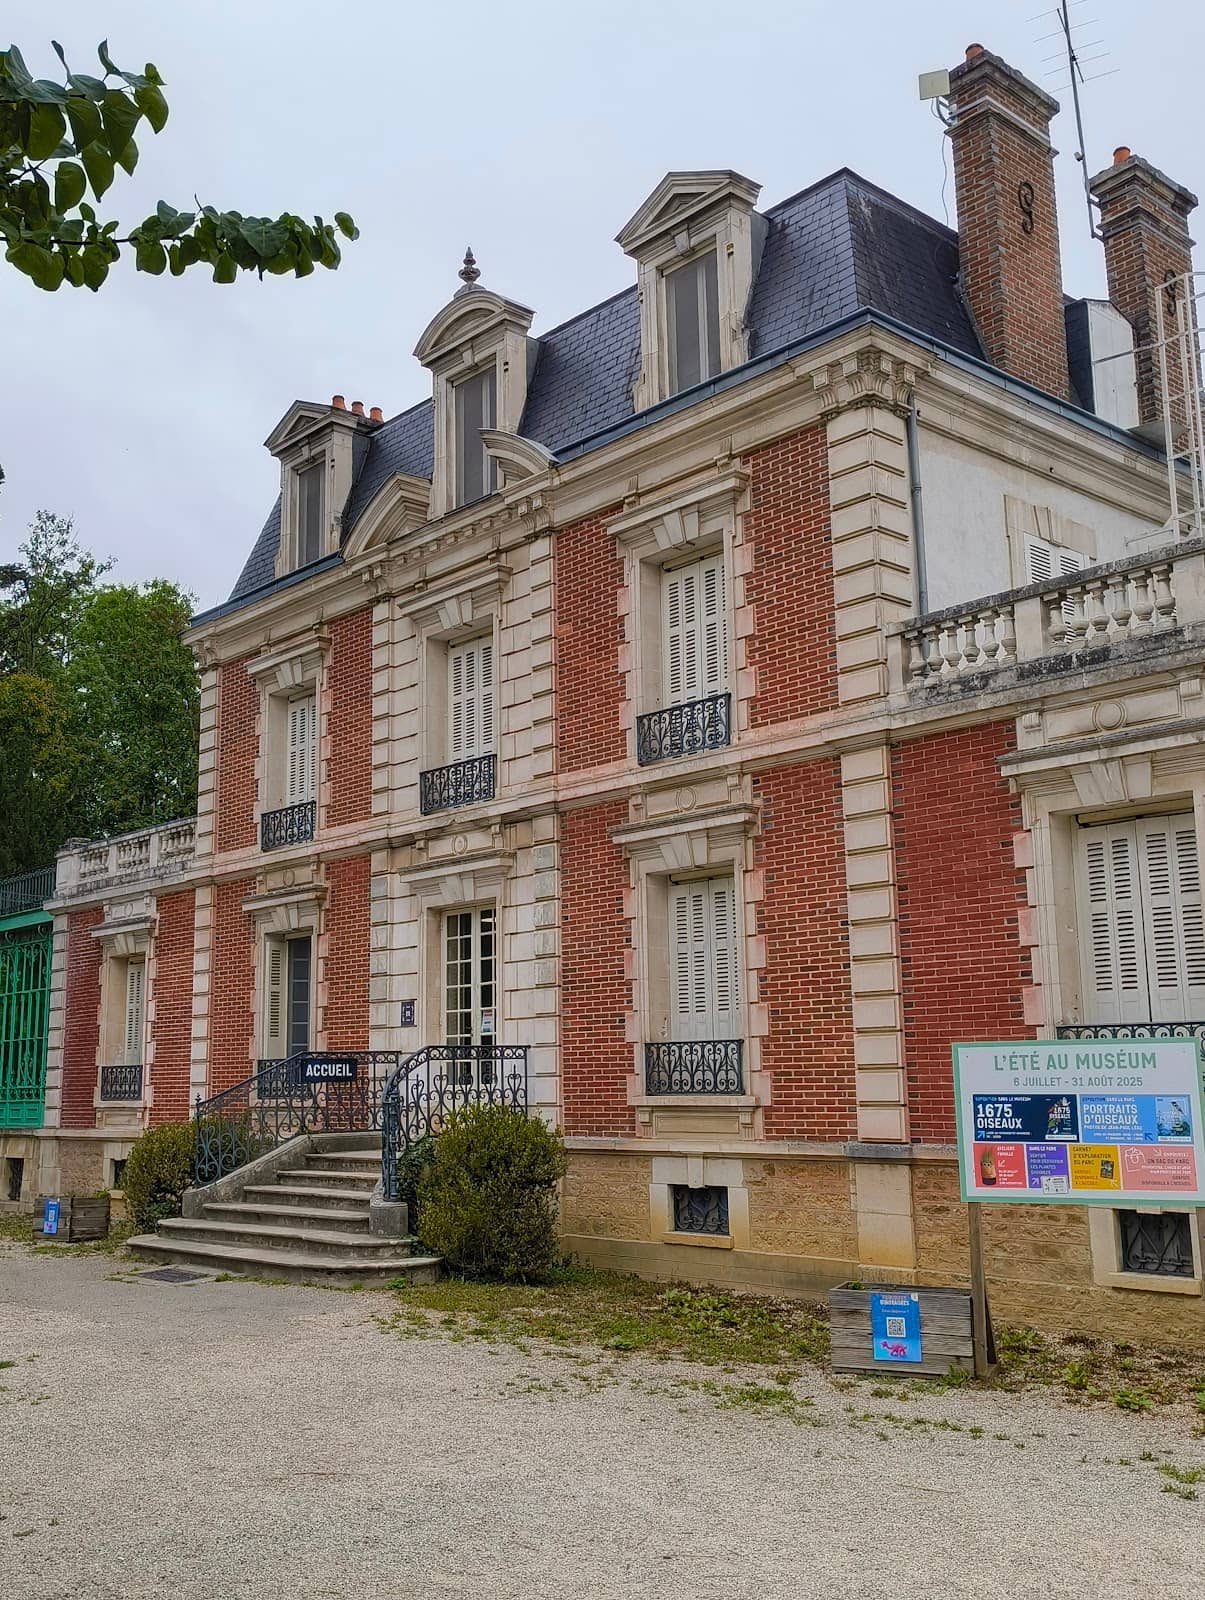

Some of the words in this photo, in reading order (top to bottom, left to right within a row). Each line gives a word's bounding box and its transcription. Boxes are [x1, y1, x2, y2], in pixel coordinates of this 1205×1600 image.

[994, 1051, 1041, 1071] L'ÉTÉ
[1046, 1053, 1069, 1070] AU
[1076, 1049, 1157, 1070] MUSÉUM
[305, 1063, 353, 1077] ACCUEIL
[1013, 1077, 1020, 1087] 6
[1023, 1076, 1062, 1087] JUILLET
[1072, 1076, 1084, 1087] 31
[1087, 1075, 1114, 1087] AOÛT
[1117, 1076, 1143, 1087] 2025
[977, 1103, 1013, 1118] 1675
[1083, 1103, 1138, 1114] PORTRAITS
[977, 1118, 1022, 1129] OISEAUX
[1084, 1114, 1139, 1125] D'OISEAUX
